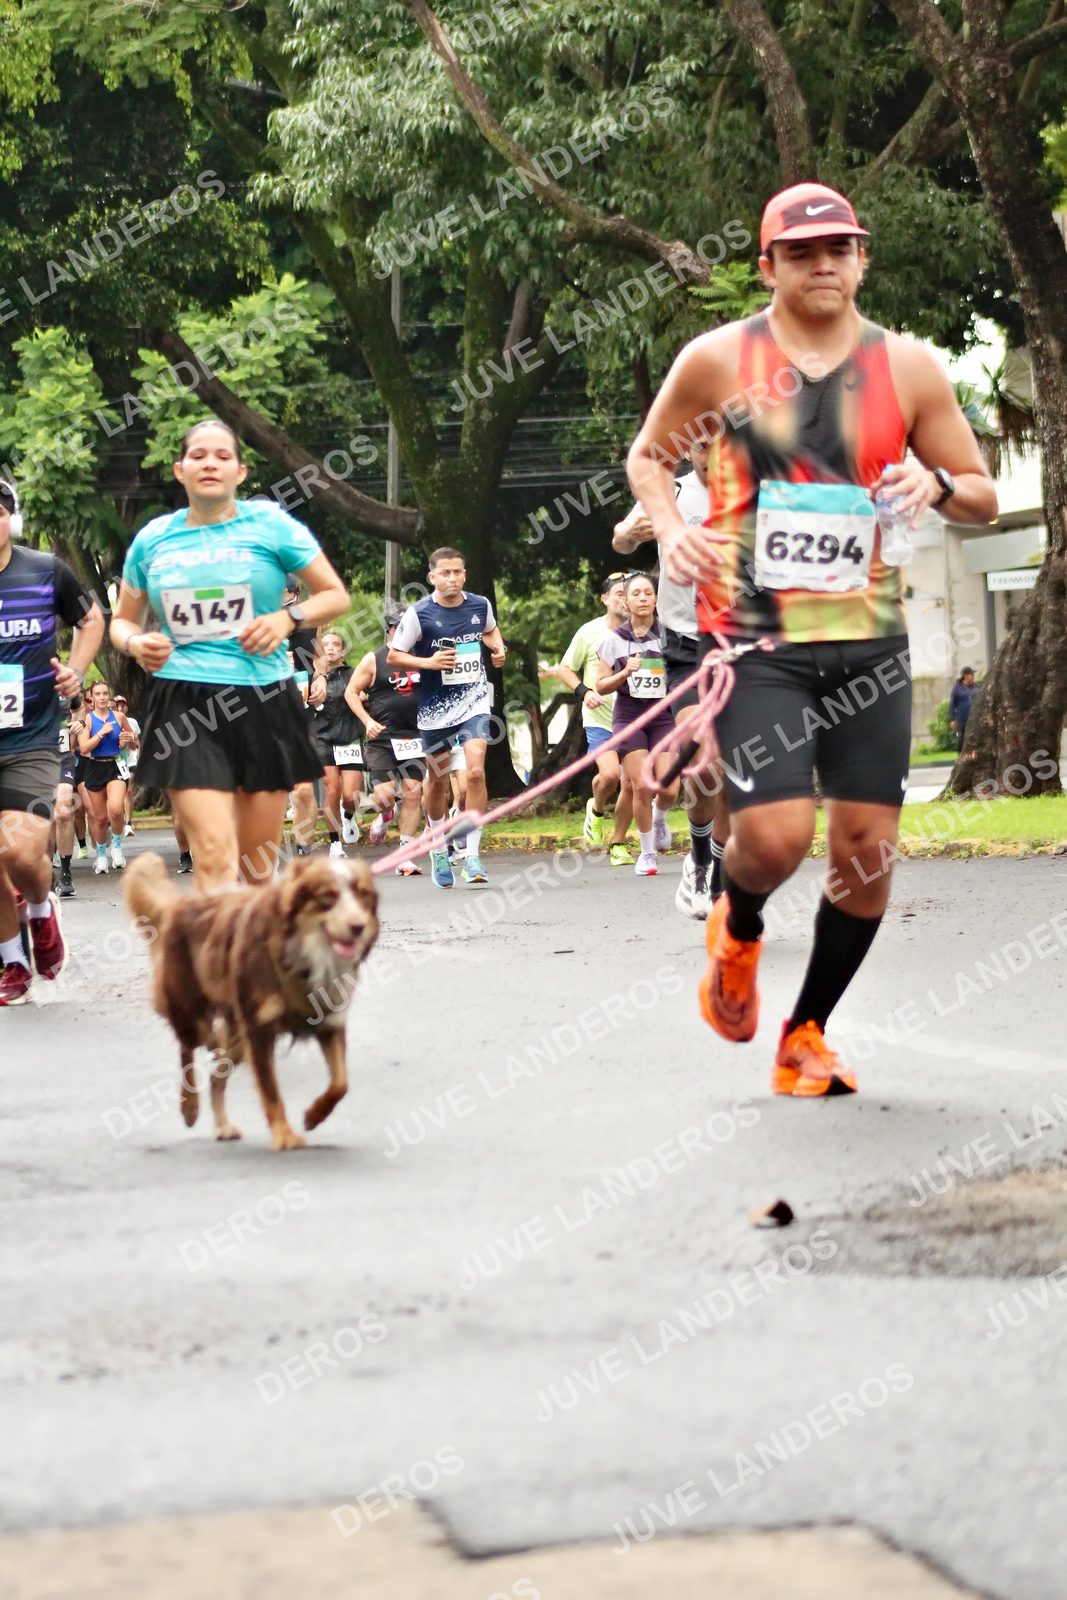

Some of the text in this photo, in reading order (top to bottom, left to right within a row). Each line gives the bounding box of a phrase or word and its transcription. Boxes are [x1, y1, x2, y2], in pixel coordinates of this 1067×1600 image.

[766, 530, 864, 565] 6294
[171, 597, 246, 626] 4147
[634, 676, 661, 689] 739
[337, 748, 361, 758] 1520
